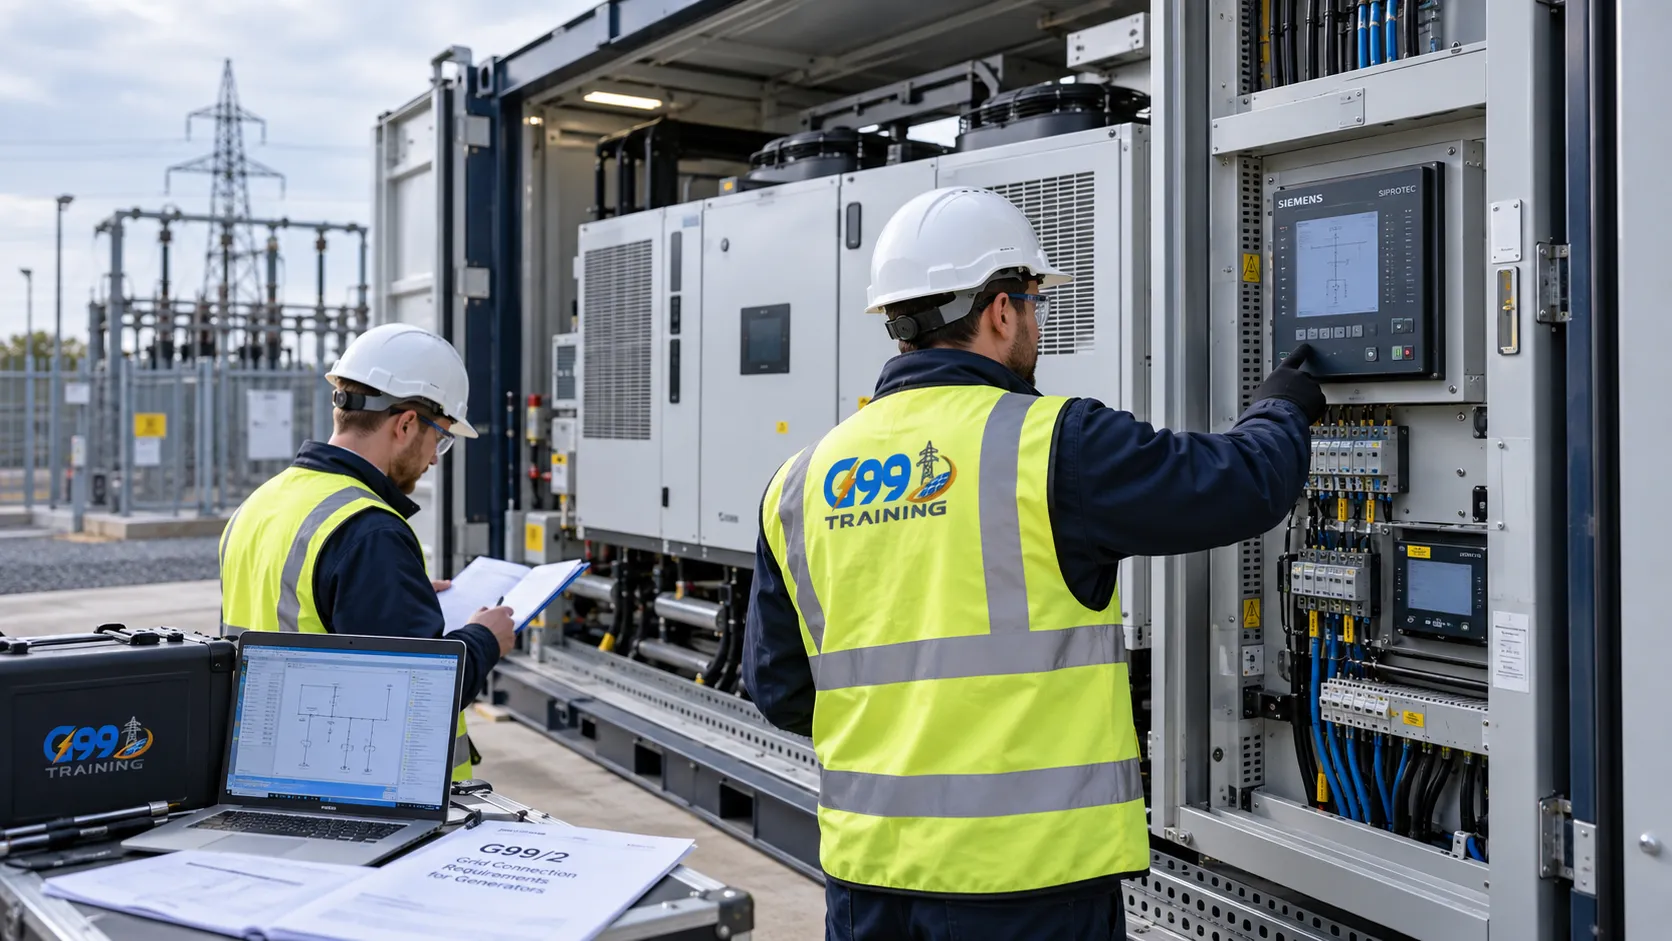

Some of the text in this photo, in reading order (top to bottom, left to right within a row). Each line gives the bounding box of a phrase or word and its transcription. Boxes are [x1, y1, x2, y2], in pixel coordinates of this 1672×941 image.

[1278, 194, 1323, 208] SIEMENS
[1378, 185, 1416, 197] SIPROTEC
[823, 453, 911, 511] G99
[825, 500, 947, 530] TRAINING
[43, 724, 119, 764] G99
[45, 759, 145, 779] TRAINING
[479, 843, 570, 863] G99/2
[442, 864, 550, 885] Requirements
[456, 857, 578, 879] Grid Connection
[427, 871, 546, 894] for Generators
